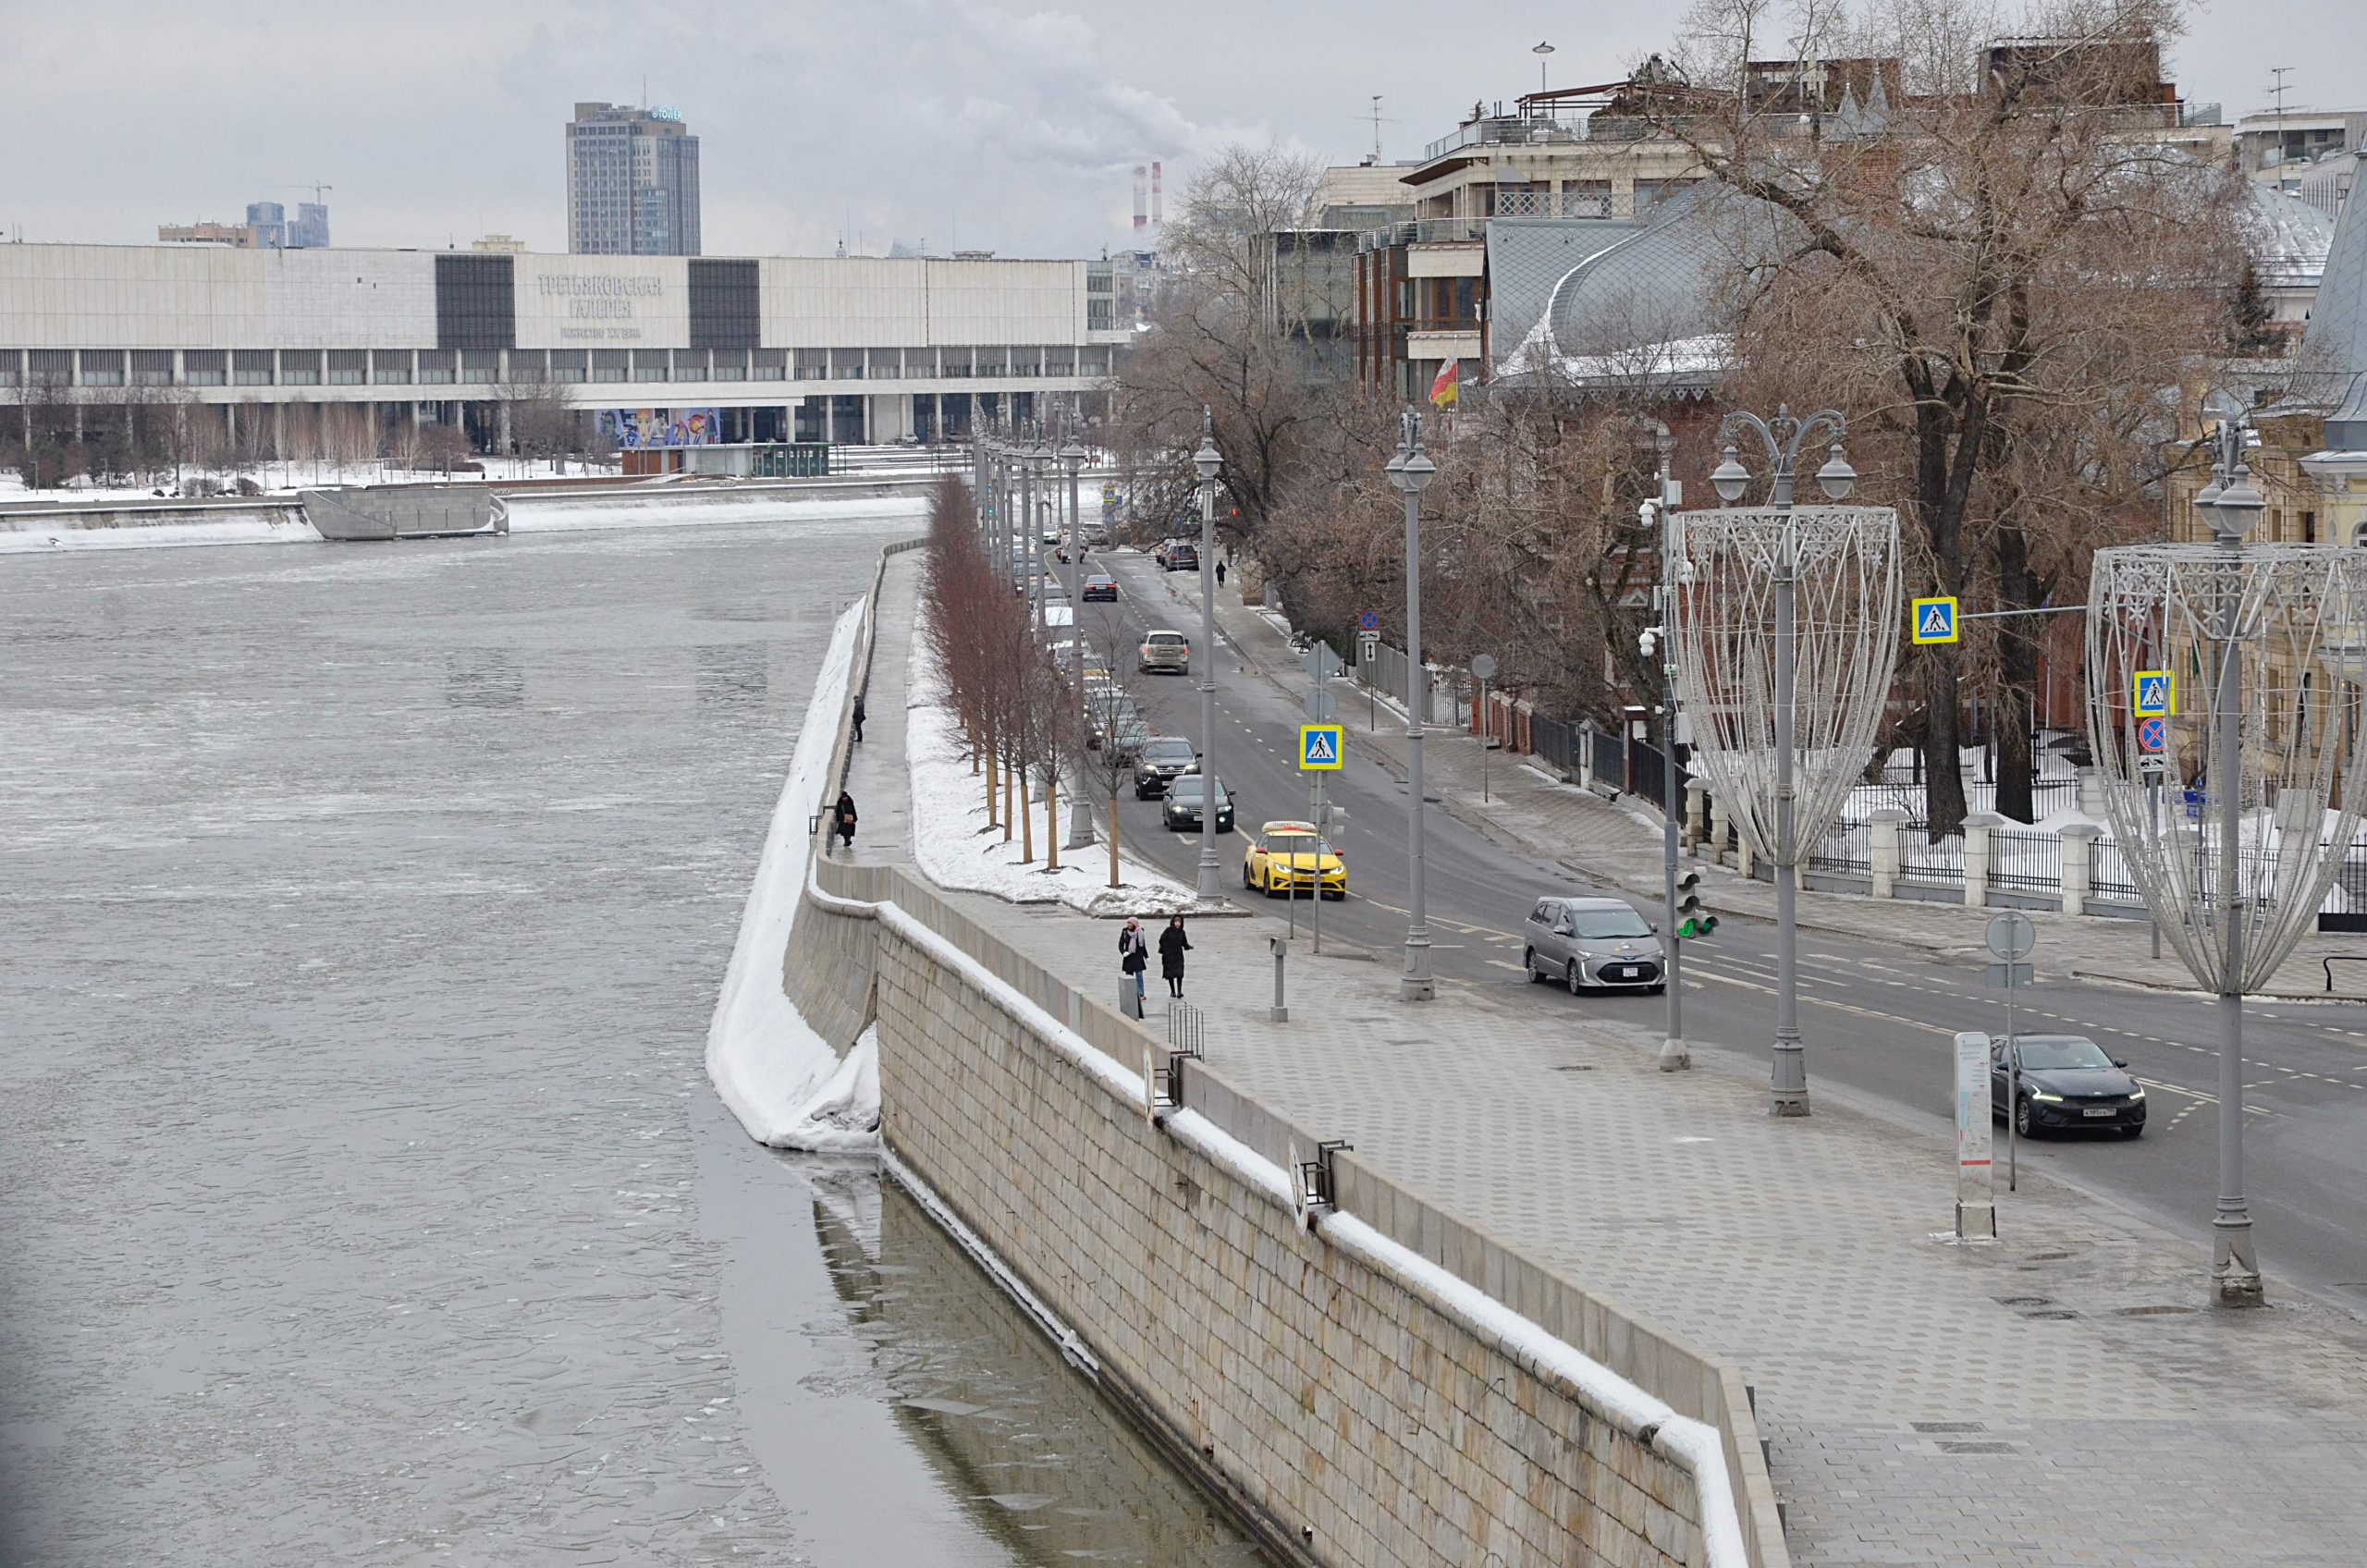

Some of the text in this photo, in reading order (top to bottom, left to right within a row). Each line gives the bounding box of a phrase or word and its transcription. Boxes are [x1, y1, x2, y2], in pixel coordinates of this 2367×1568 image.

[658, 109, 681, 119] TOWER
[537, 275, 663, 296] ТРЕТЬЯКОВСКАЯ
[570, 298, 632, 319] ГАЛЕРЕЯ
